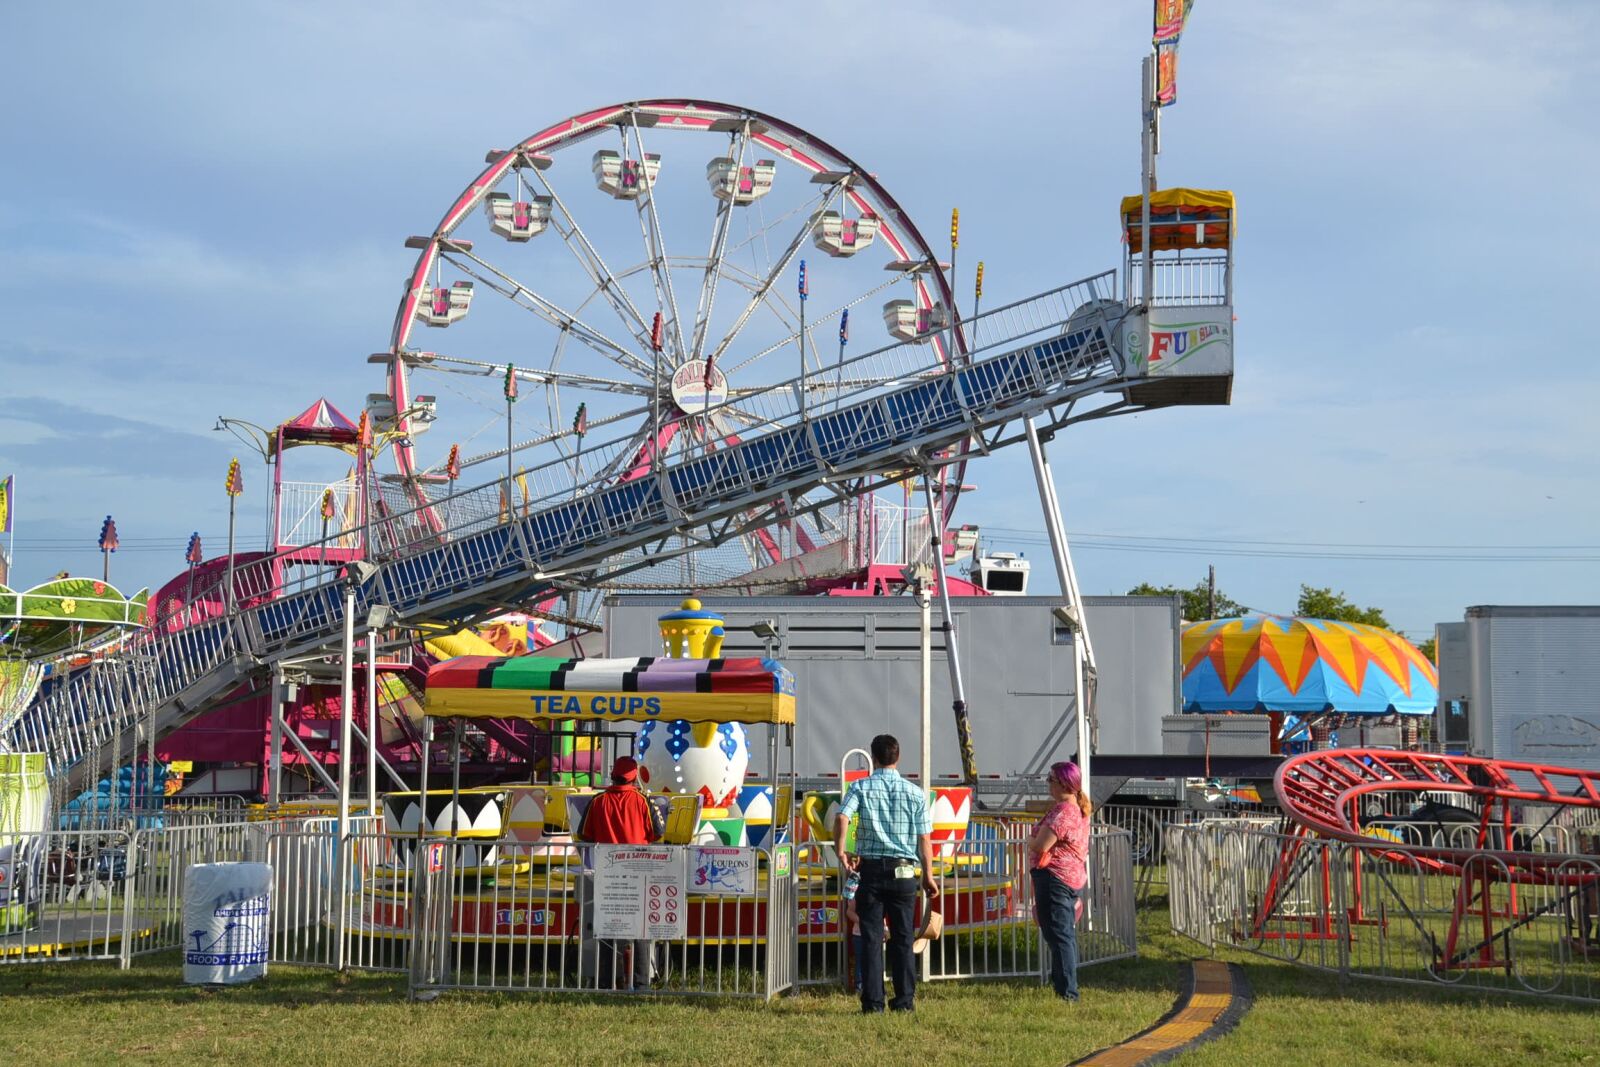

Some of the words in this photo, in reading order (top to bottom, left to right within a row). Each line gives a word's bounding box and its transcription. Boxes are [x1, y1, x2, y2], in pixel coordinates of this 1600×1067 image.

[674, 363, 724, 389] TALLY
[530, 695, 581, 714] TEA
[590, 695, 661, 716] CUPS
[712, 860, 749, 868] COUPONS
[695, 866, 707, 885] 3
[193, 955, 220, 964] FOOD
[229, 955, 251, 964] FUN
